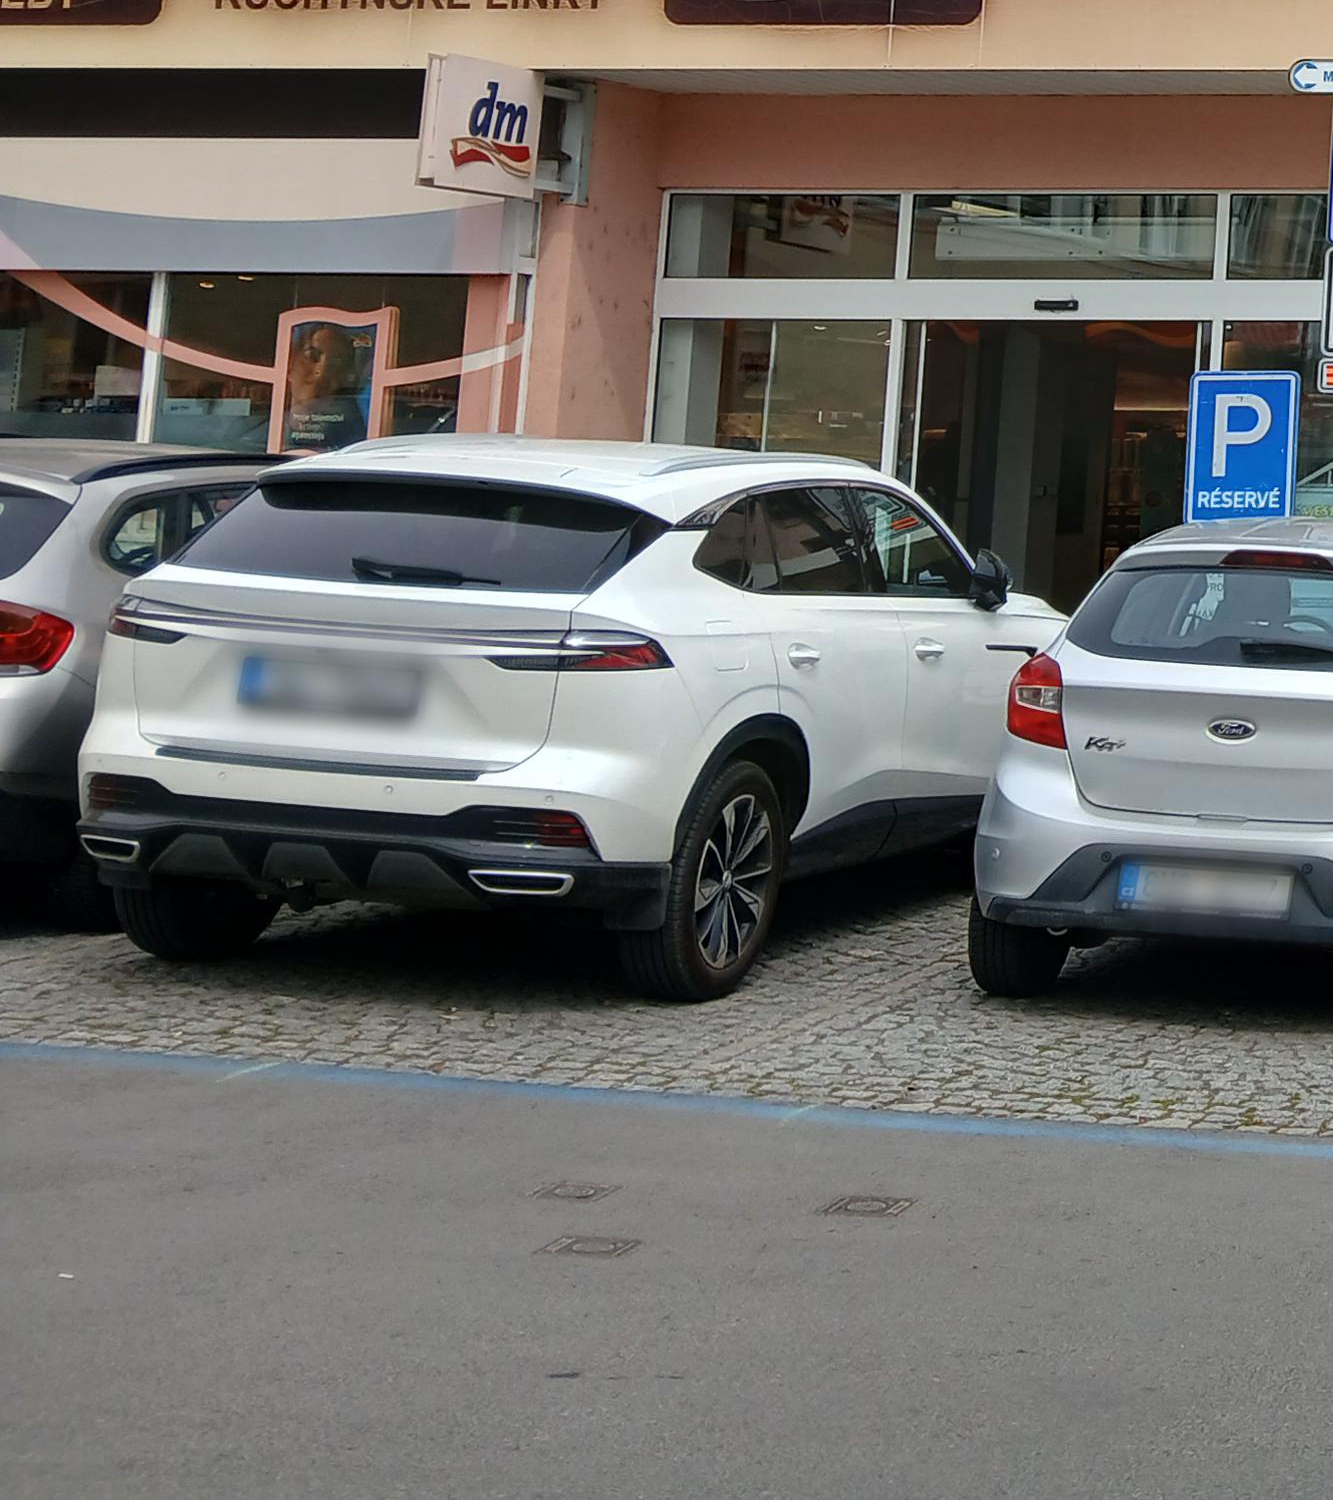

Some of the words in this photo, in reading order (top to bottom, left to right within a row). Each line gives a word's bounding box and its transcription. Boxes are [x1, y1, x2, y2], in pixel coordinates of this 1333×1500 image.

[468, 81, 529, 144] dm
[1211, 393, 1272, 478] P
[1197, 486, 1281, 510] RÉSERVÉ
[1217, 723, 1245, 736] Ford
[1121, 886, 1135, 896] CZ
